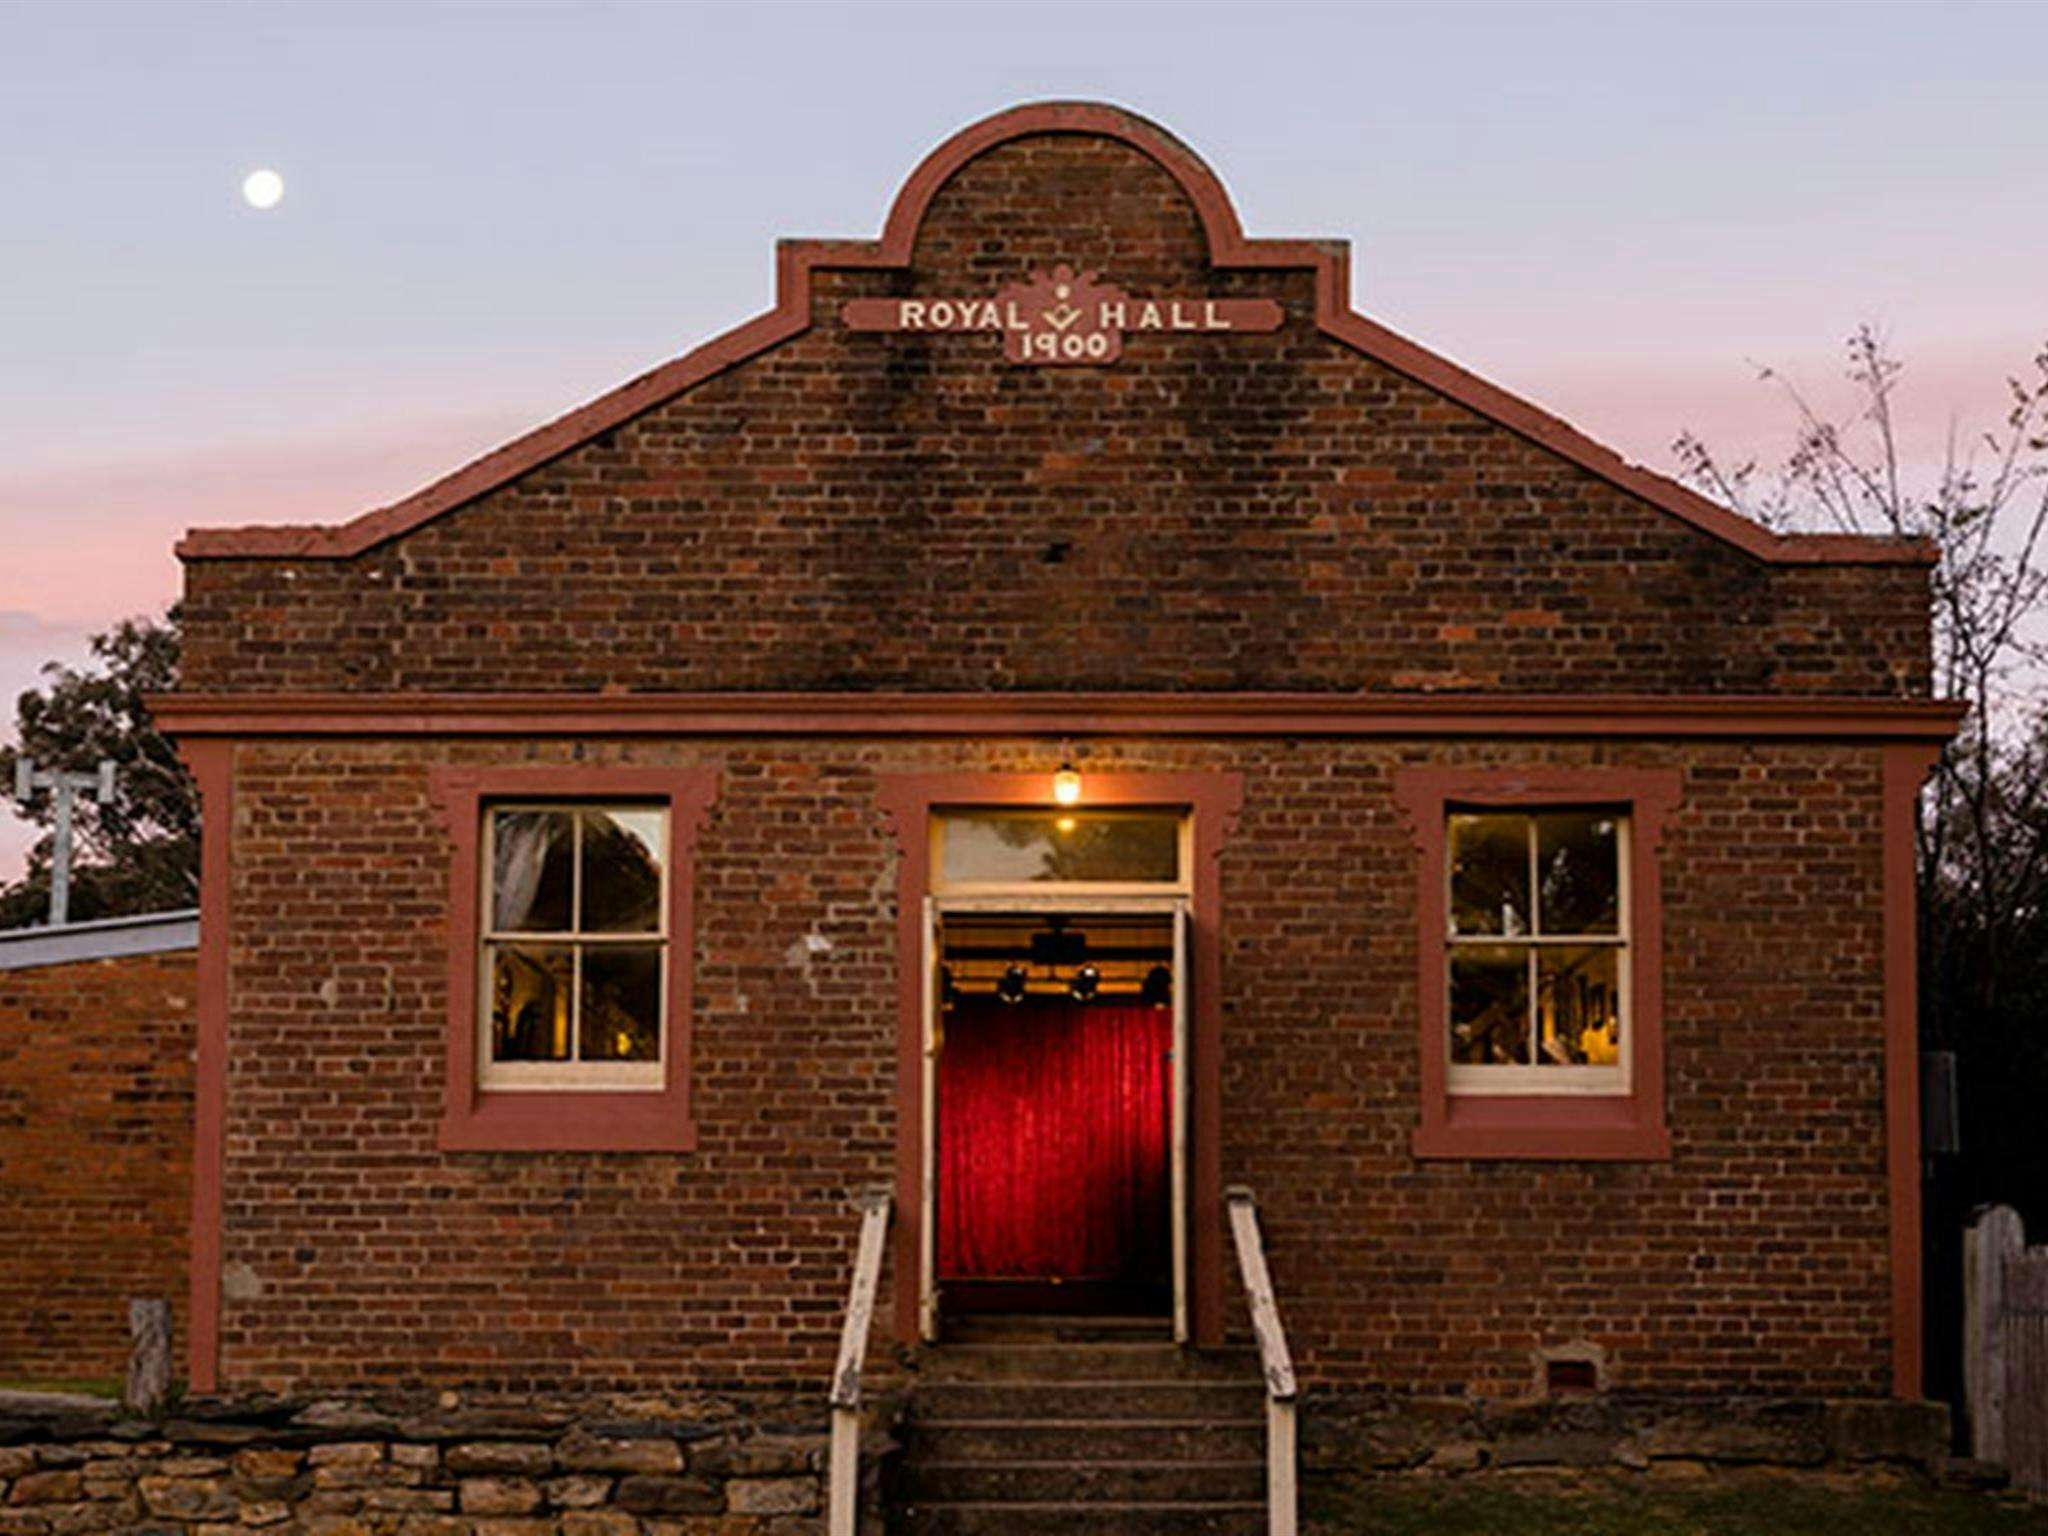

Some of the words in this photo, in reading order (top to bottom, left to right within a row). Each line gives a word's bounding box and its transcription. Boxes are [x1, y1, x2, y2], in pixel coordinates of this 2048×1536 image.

[899, 301, 1030, 329] ROYAL
[1101, 301, 1231, 329] HALL
[1021, 333, 1108, 358] 1900
